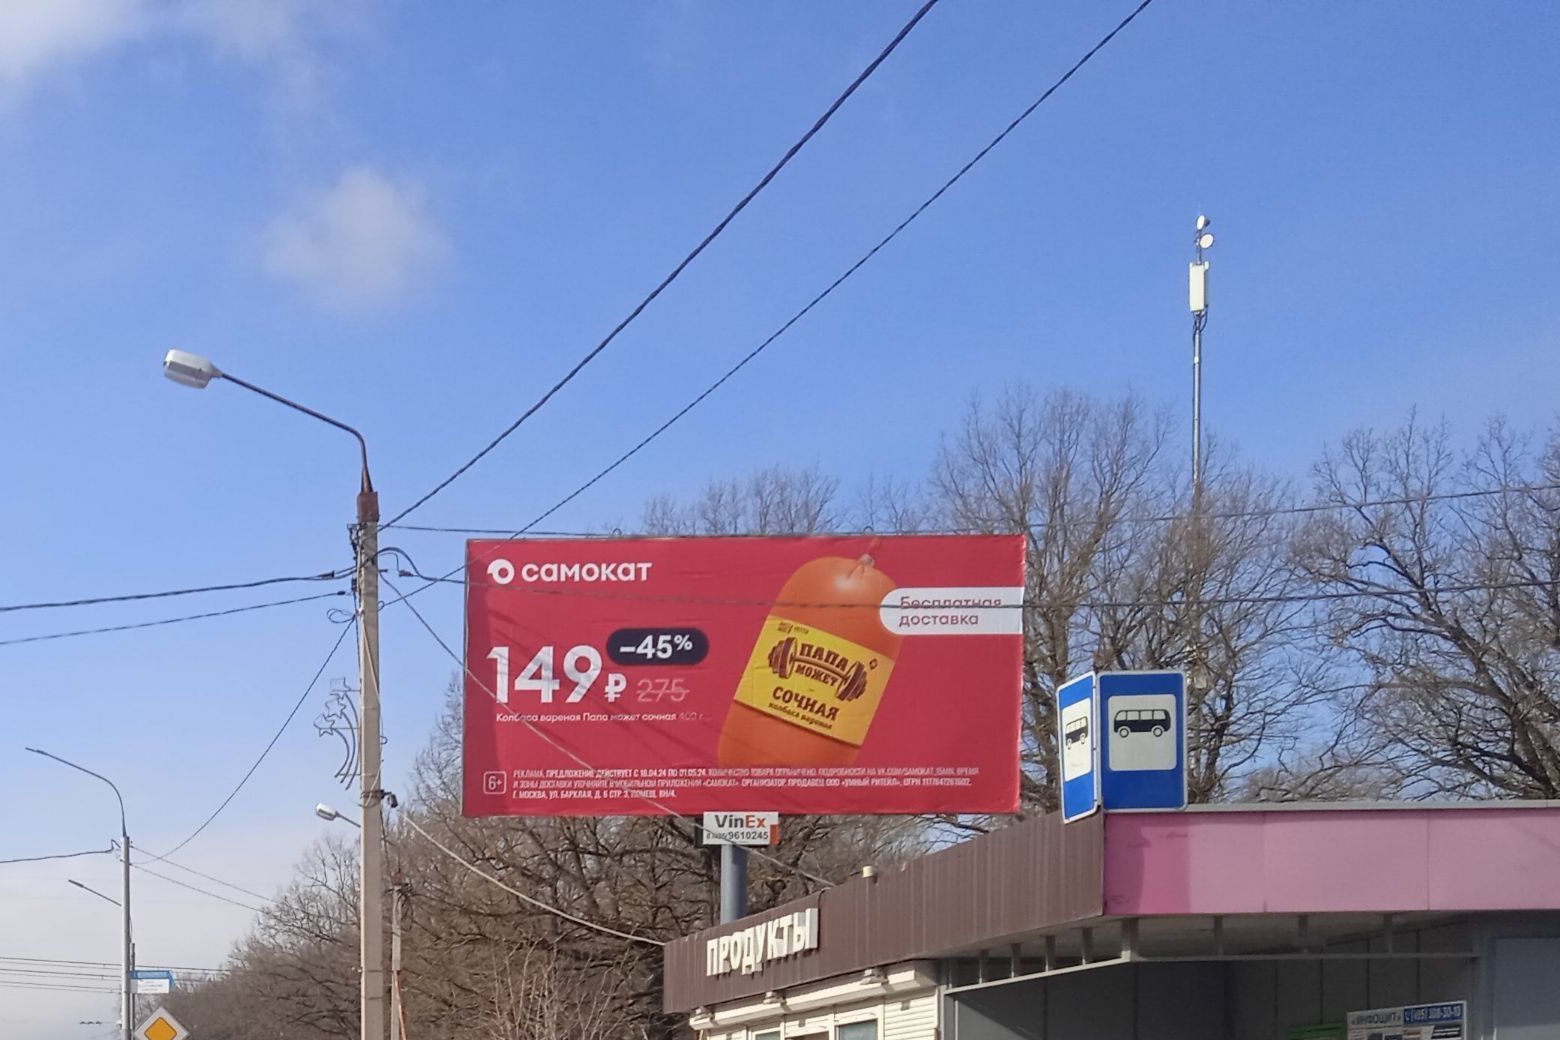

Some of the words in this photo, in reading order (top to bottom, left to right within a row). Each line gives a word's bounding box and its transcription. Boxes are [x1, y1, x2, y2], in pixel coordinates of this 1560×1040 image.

[521, 562, 652, 582] самокат
[899, 614, 979, 627] доставка
[800, 643, 849, 672] ПАПА
[795, 663, 840, 687] МОЖЕТ
[637, 678, 689, 703] 275
[772, 686, 840, 721] СОЧНАЯ
[488, 775, 503, 790] 6+
[714, 814, 766, 828] VinEx
[706, 907, 819, 976] ПРОДУКТЫ
